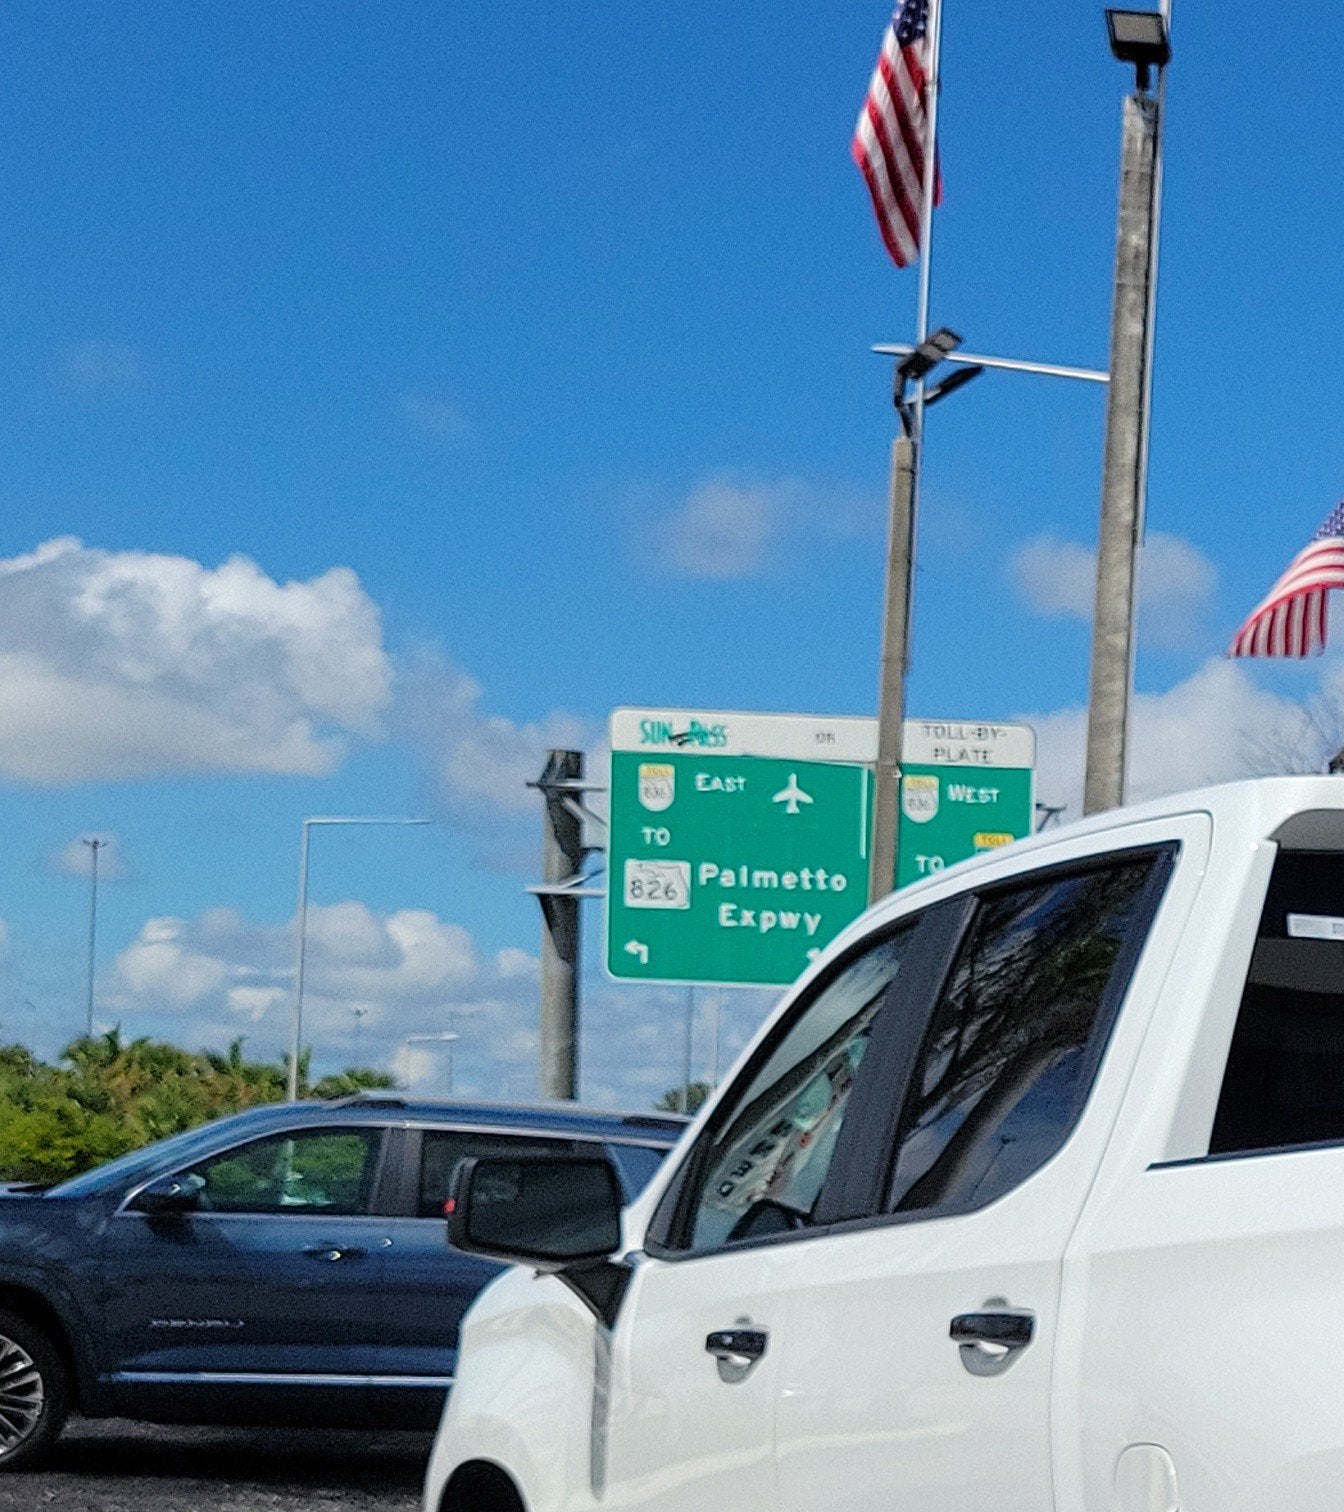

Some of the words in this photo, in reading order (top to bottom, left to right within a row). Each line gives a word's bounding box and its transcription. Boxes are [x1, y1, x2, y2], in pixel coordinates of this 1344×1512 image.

[815, 732, 837, 744] OR
[934, 747, 993, 764] PLATE
[695, 772, 746, 792] EAST
[948, 783, 1000, 803] WEST
[641, 826, 671, 845] TO
[914, 854, 945, 875] TO
[699, 862, 847, 892] Palmetto
[630, 878, 679, 900] 826
[718, 902, 822, 936] Expwy
